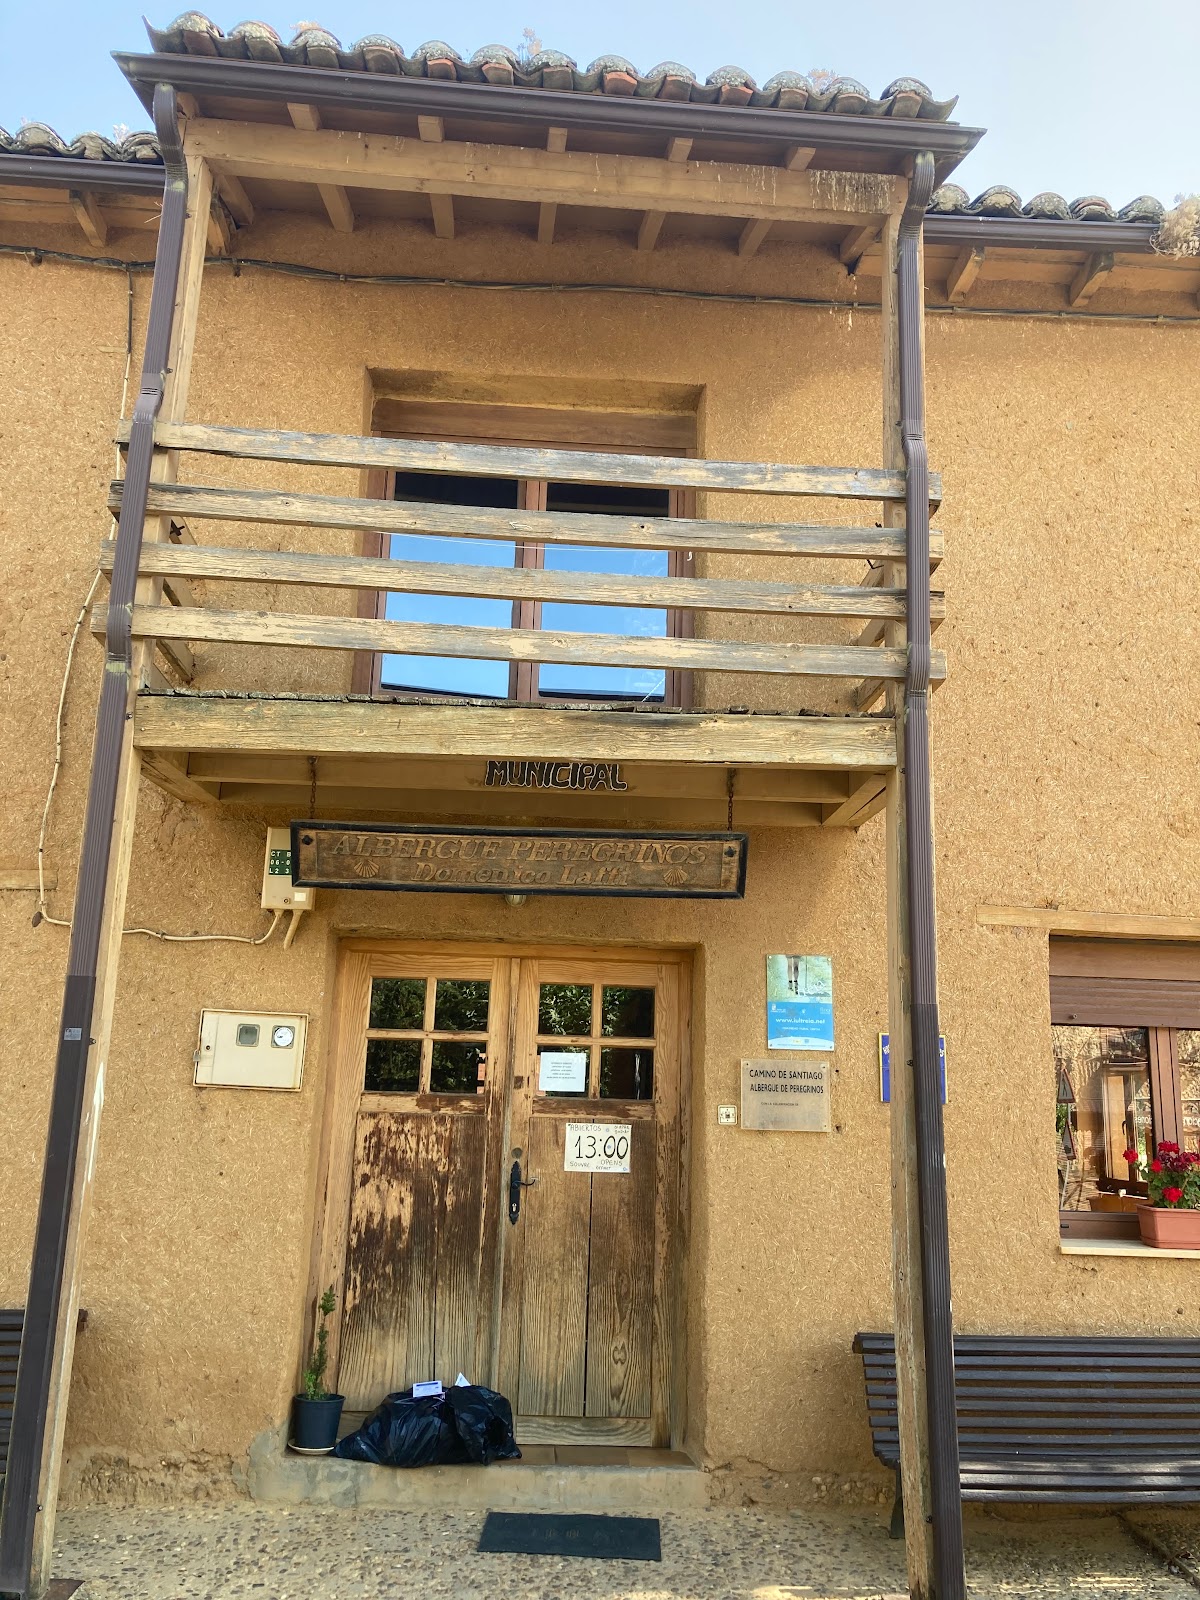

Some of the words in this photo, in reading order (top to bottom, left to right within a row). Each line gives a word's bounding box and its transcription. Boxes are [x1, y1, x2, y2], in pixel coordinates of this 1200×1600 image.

[485, 760, 628, 791] MUNICIPAL
[331, 835, 501, 861] ALBERGUE
[506, 840, 711, 865] PEREGRINOS
[411, 861, 551, 885] Domenico
[749, 1069, 777, 1078] CAMINO
[778, 1070, 787, 1079] DE
[789, 1070, 823, 1080] SANTIAGO
[750, 1083, 779, 1092] ALBERGUE
[780, 1084, 788, 1093] DE
[789, 1084, 824, 1094] PEREGRINOS
[574, 1135, 629, 1160] 13:00
